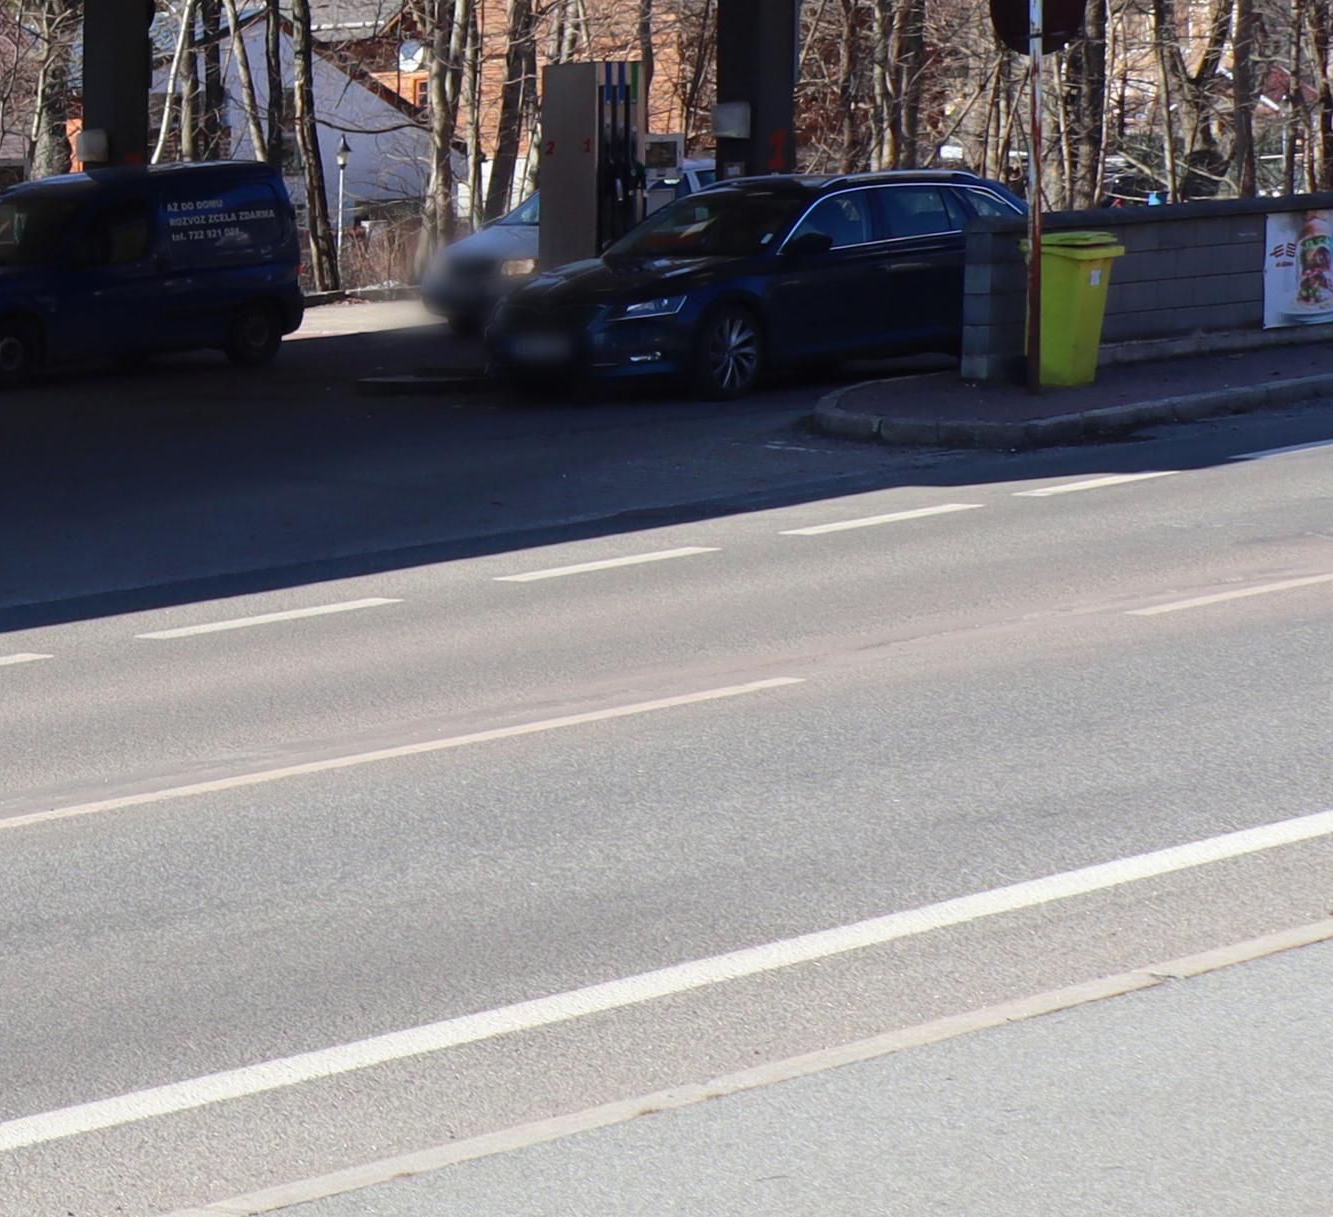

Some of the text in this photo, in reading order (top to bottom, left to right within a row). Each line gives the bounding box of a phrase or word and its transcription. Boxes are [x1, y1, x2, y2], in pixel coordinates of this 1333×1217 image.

[169, 209, 276, 226] ROZVOZ ZCELA ZDARMA
